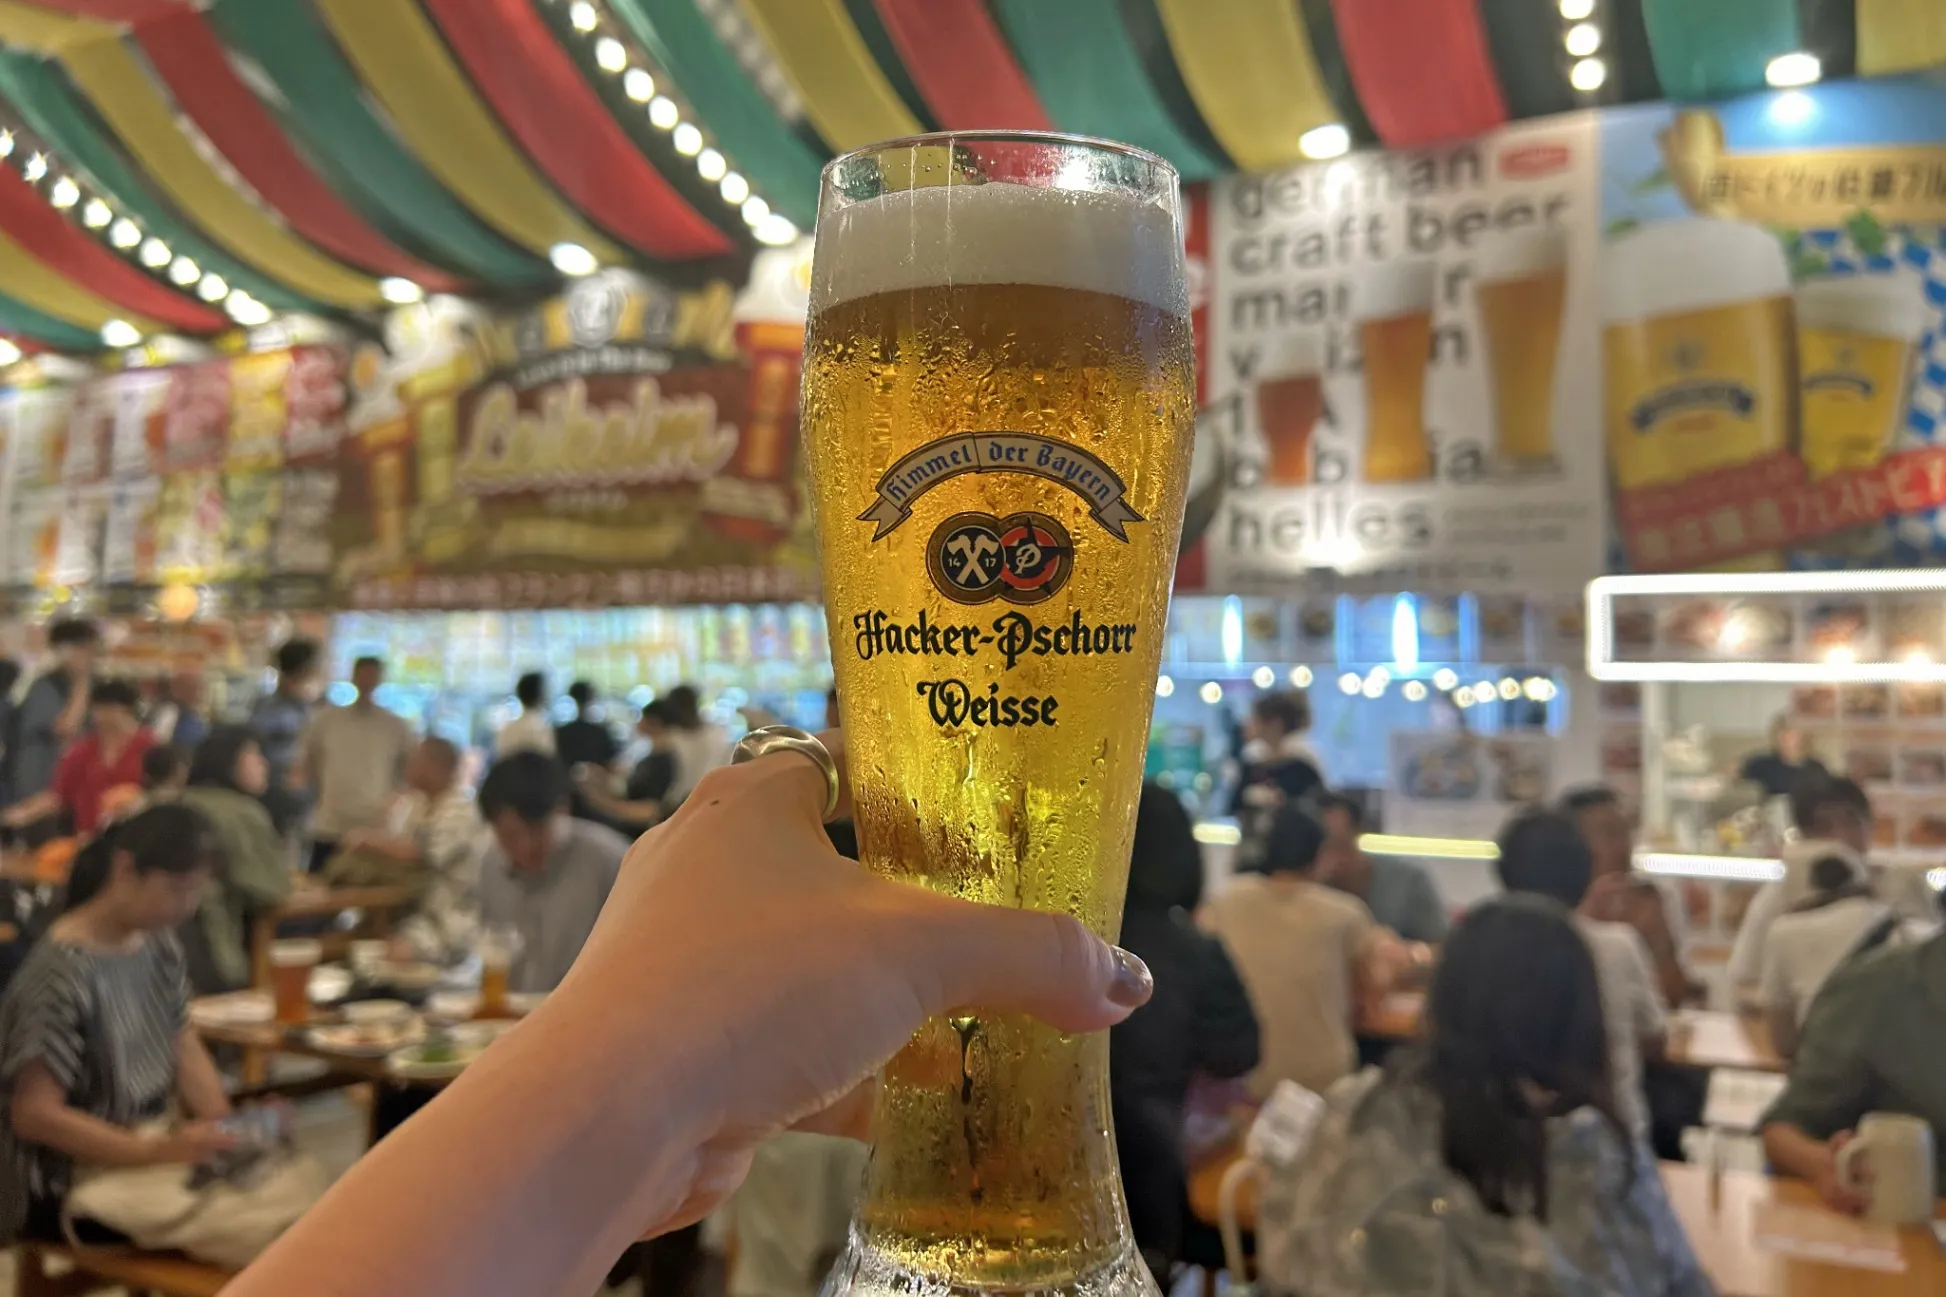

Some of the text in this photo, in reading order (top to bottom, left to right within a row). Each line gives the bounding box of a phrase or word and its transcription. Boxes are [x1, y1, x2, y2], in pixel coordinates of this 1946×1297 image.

[1230, 212, 1389, 271] craft
[887, 440, 1112, 501] Himmel der Bayern
[1229, 491, 1435, 556] helles
[947, 557, 997, 568] 14 17
[854, 608, 1137, 671] Hacker-Pschorr
[917, 678, 1060, 728] Weisse
